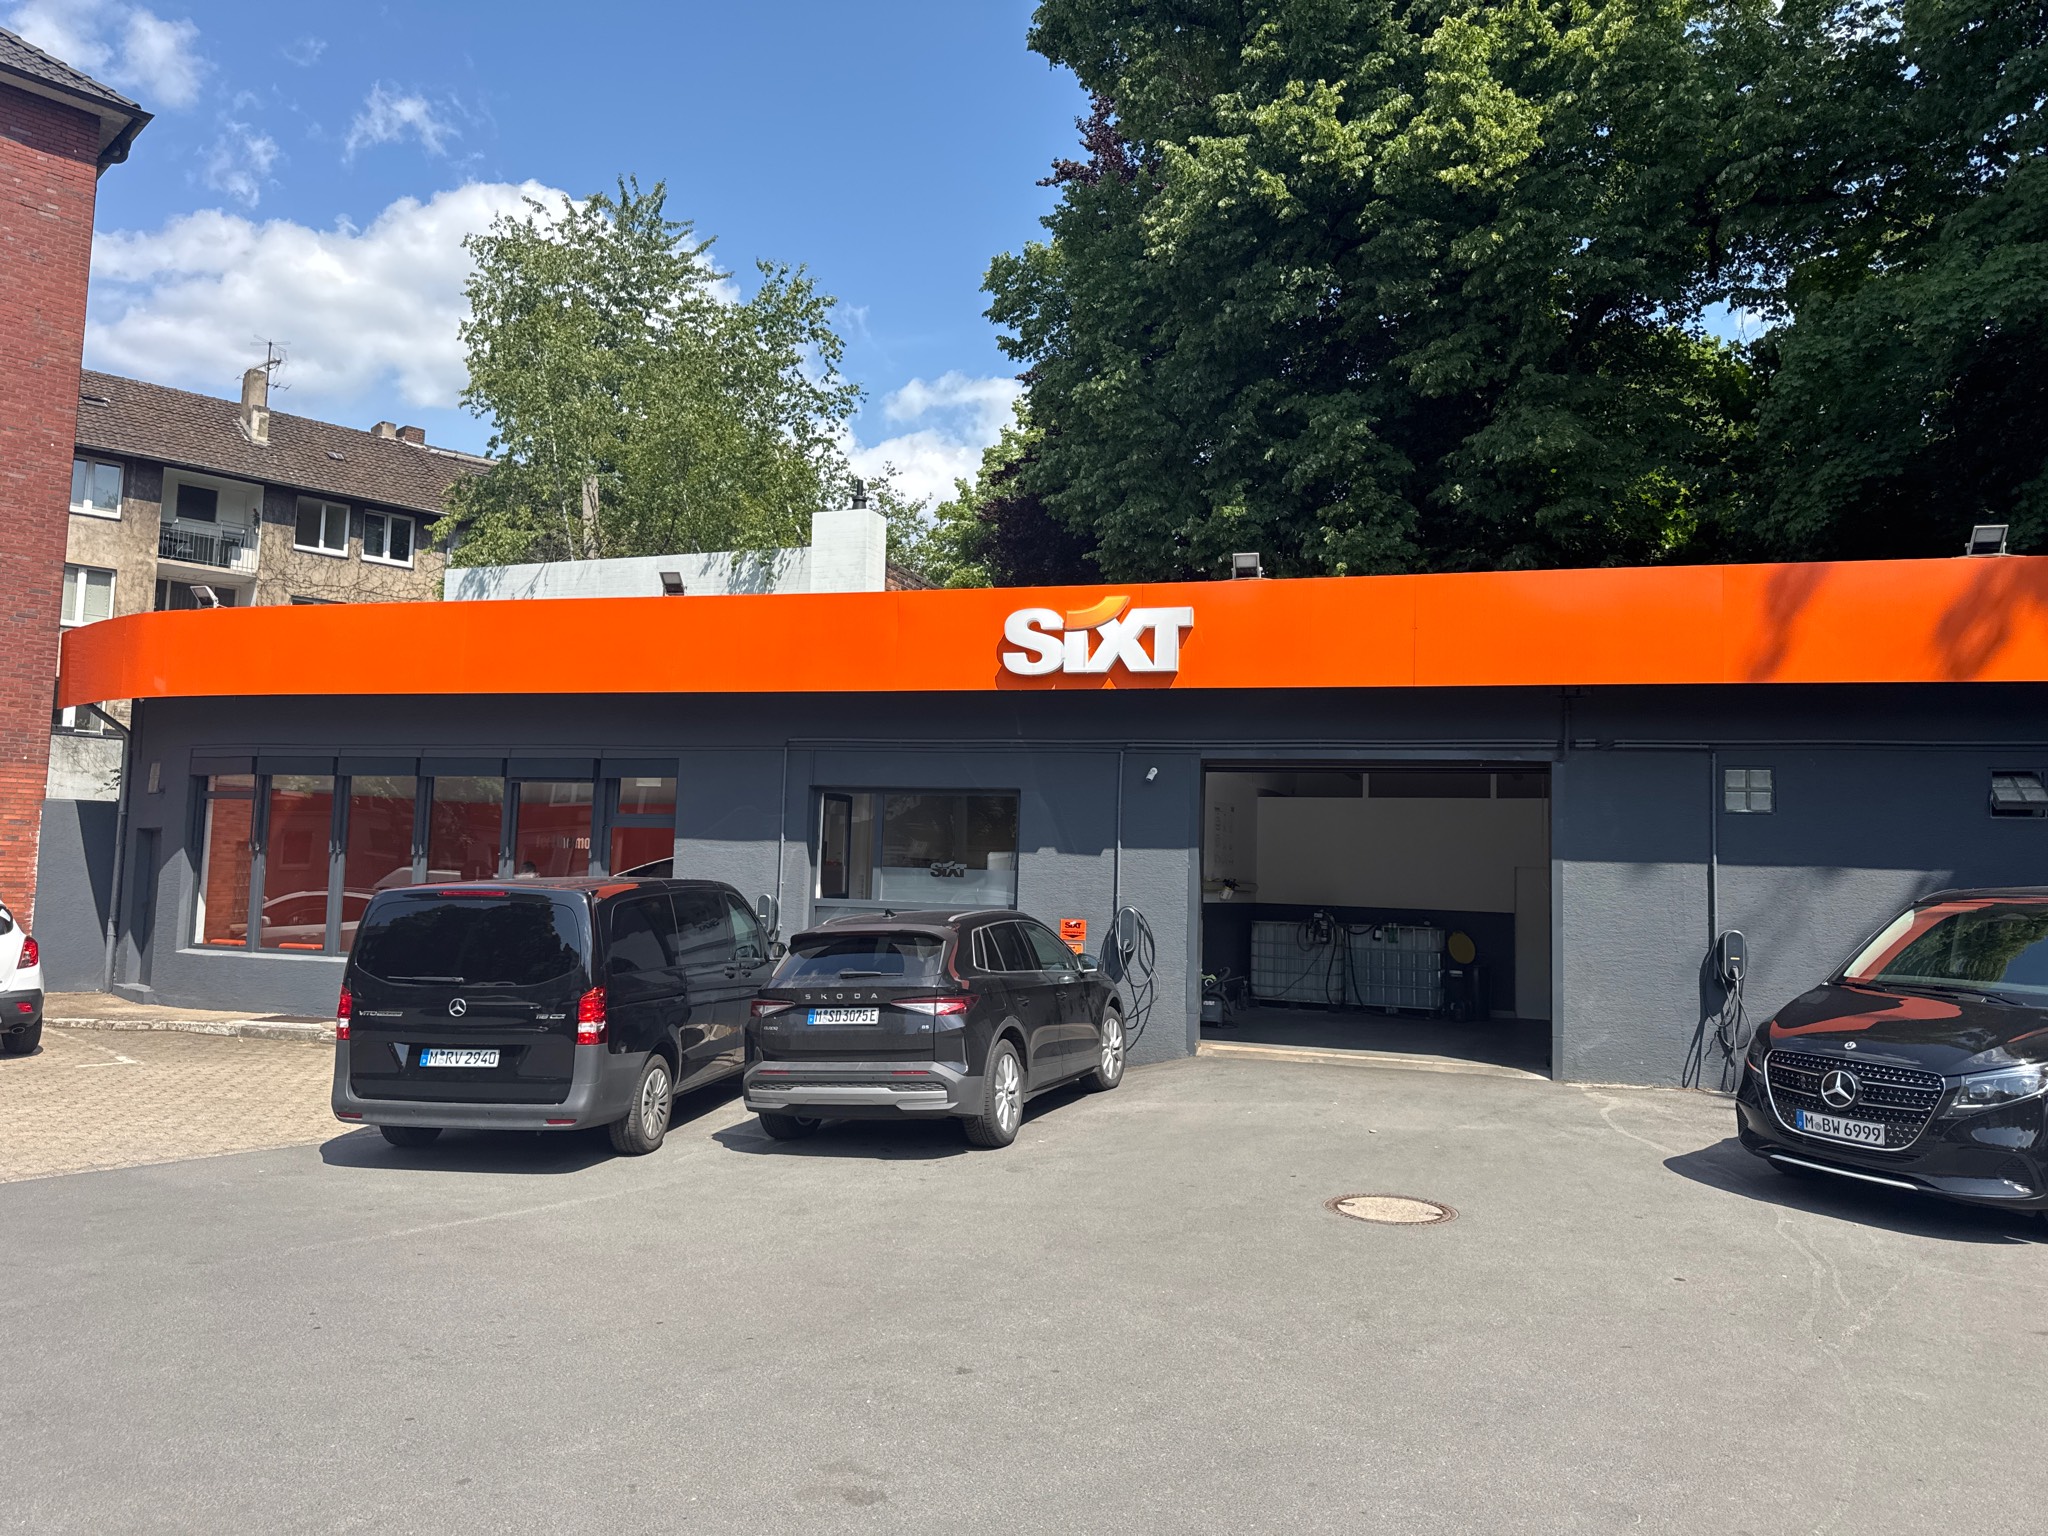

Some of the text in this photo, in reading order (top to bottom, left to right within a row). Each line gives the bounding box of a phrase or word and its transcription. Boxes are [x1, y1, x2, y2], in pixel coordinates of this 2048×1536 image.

[1003, 595, 1194, 675] SIXT
[930, 861, 968, 878] SIXT
[1844, 1122, 1881, 1142] 6999
